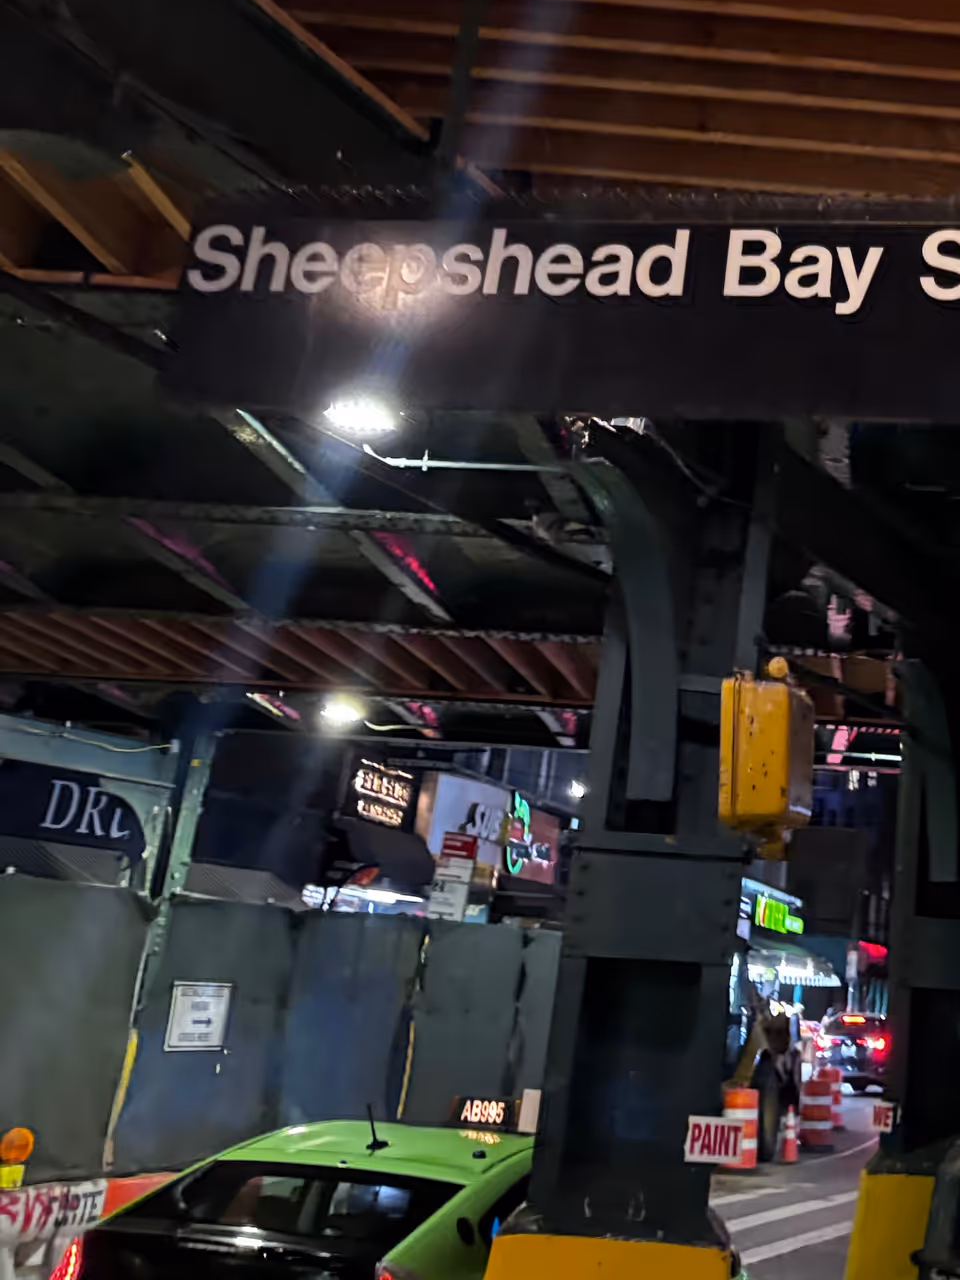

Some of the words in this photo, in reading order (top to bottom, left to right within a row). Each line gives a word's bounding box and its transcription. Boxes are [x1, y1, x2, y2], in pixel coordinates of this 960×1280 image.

[187, 224, 690, 310] Sheepshead
[722, 228, 884, 315] Bay
[461, 1099, 505, 1124] AB995
[689, 1123, 742, 1157] PAINT
